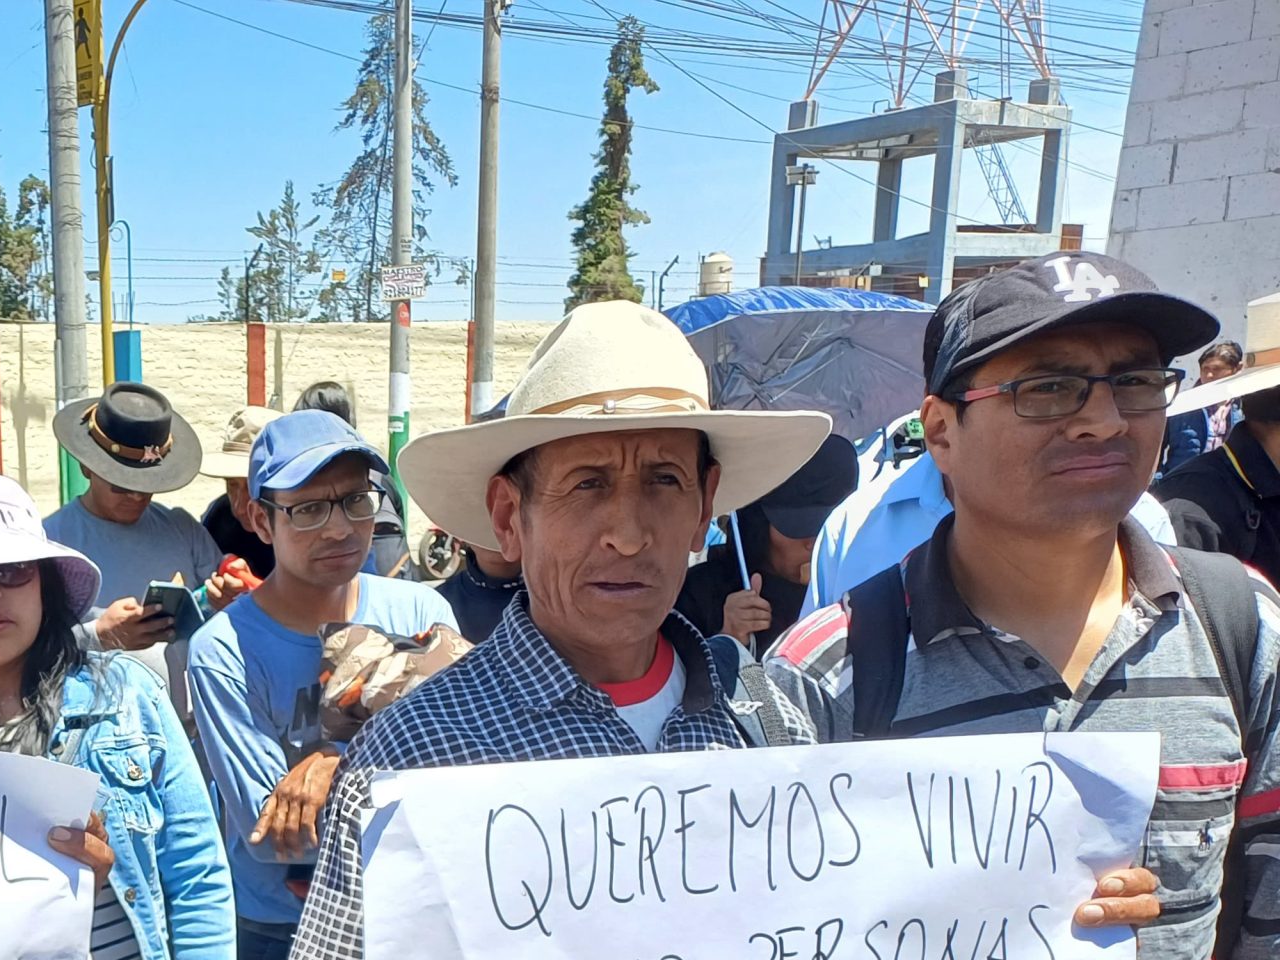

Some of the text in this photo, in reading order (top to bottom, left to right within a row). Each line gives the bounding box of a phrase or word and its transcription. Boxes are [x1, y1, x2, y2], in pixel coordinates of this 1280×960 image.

[1044, 256, 1120, 302] LA
[485, 761, 1058, 937] QUEREMOS VIVIR
